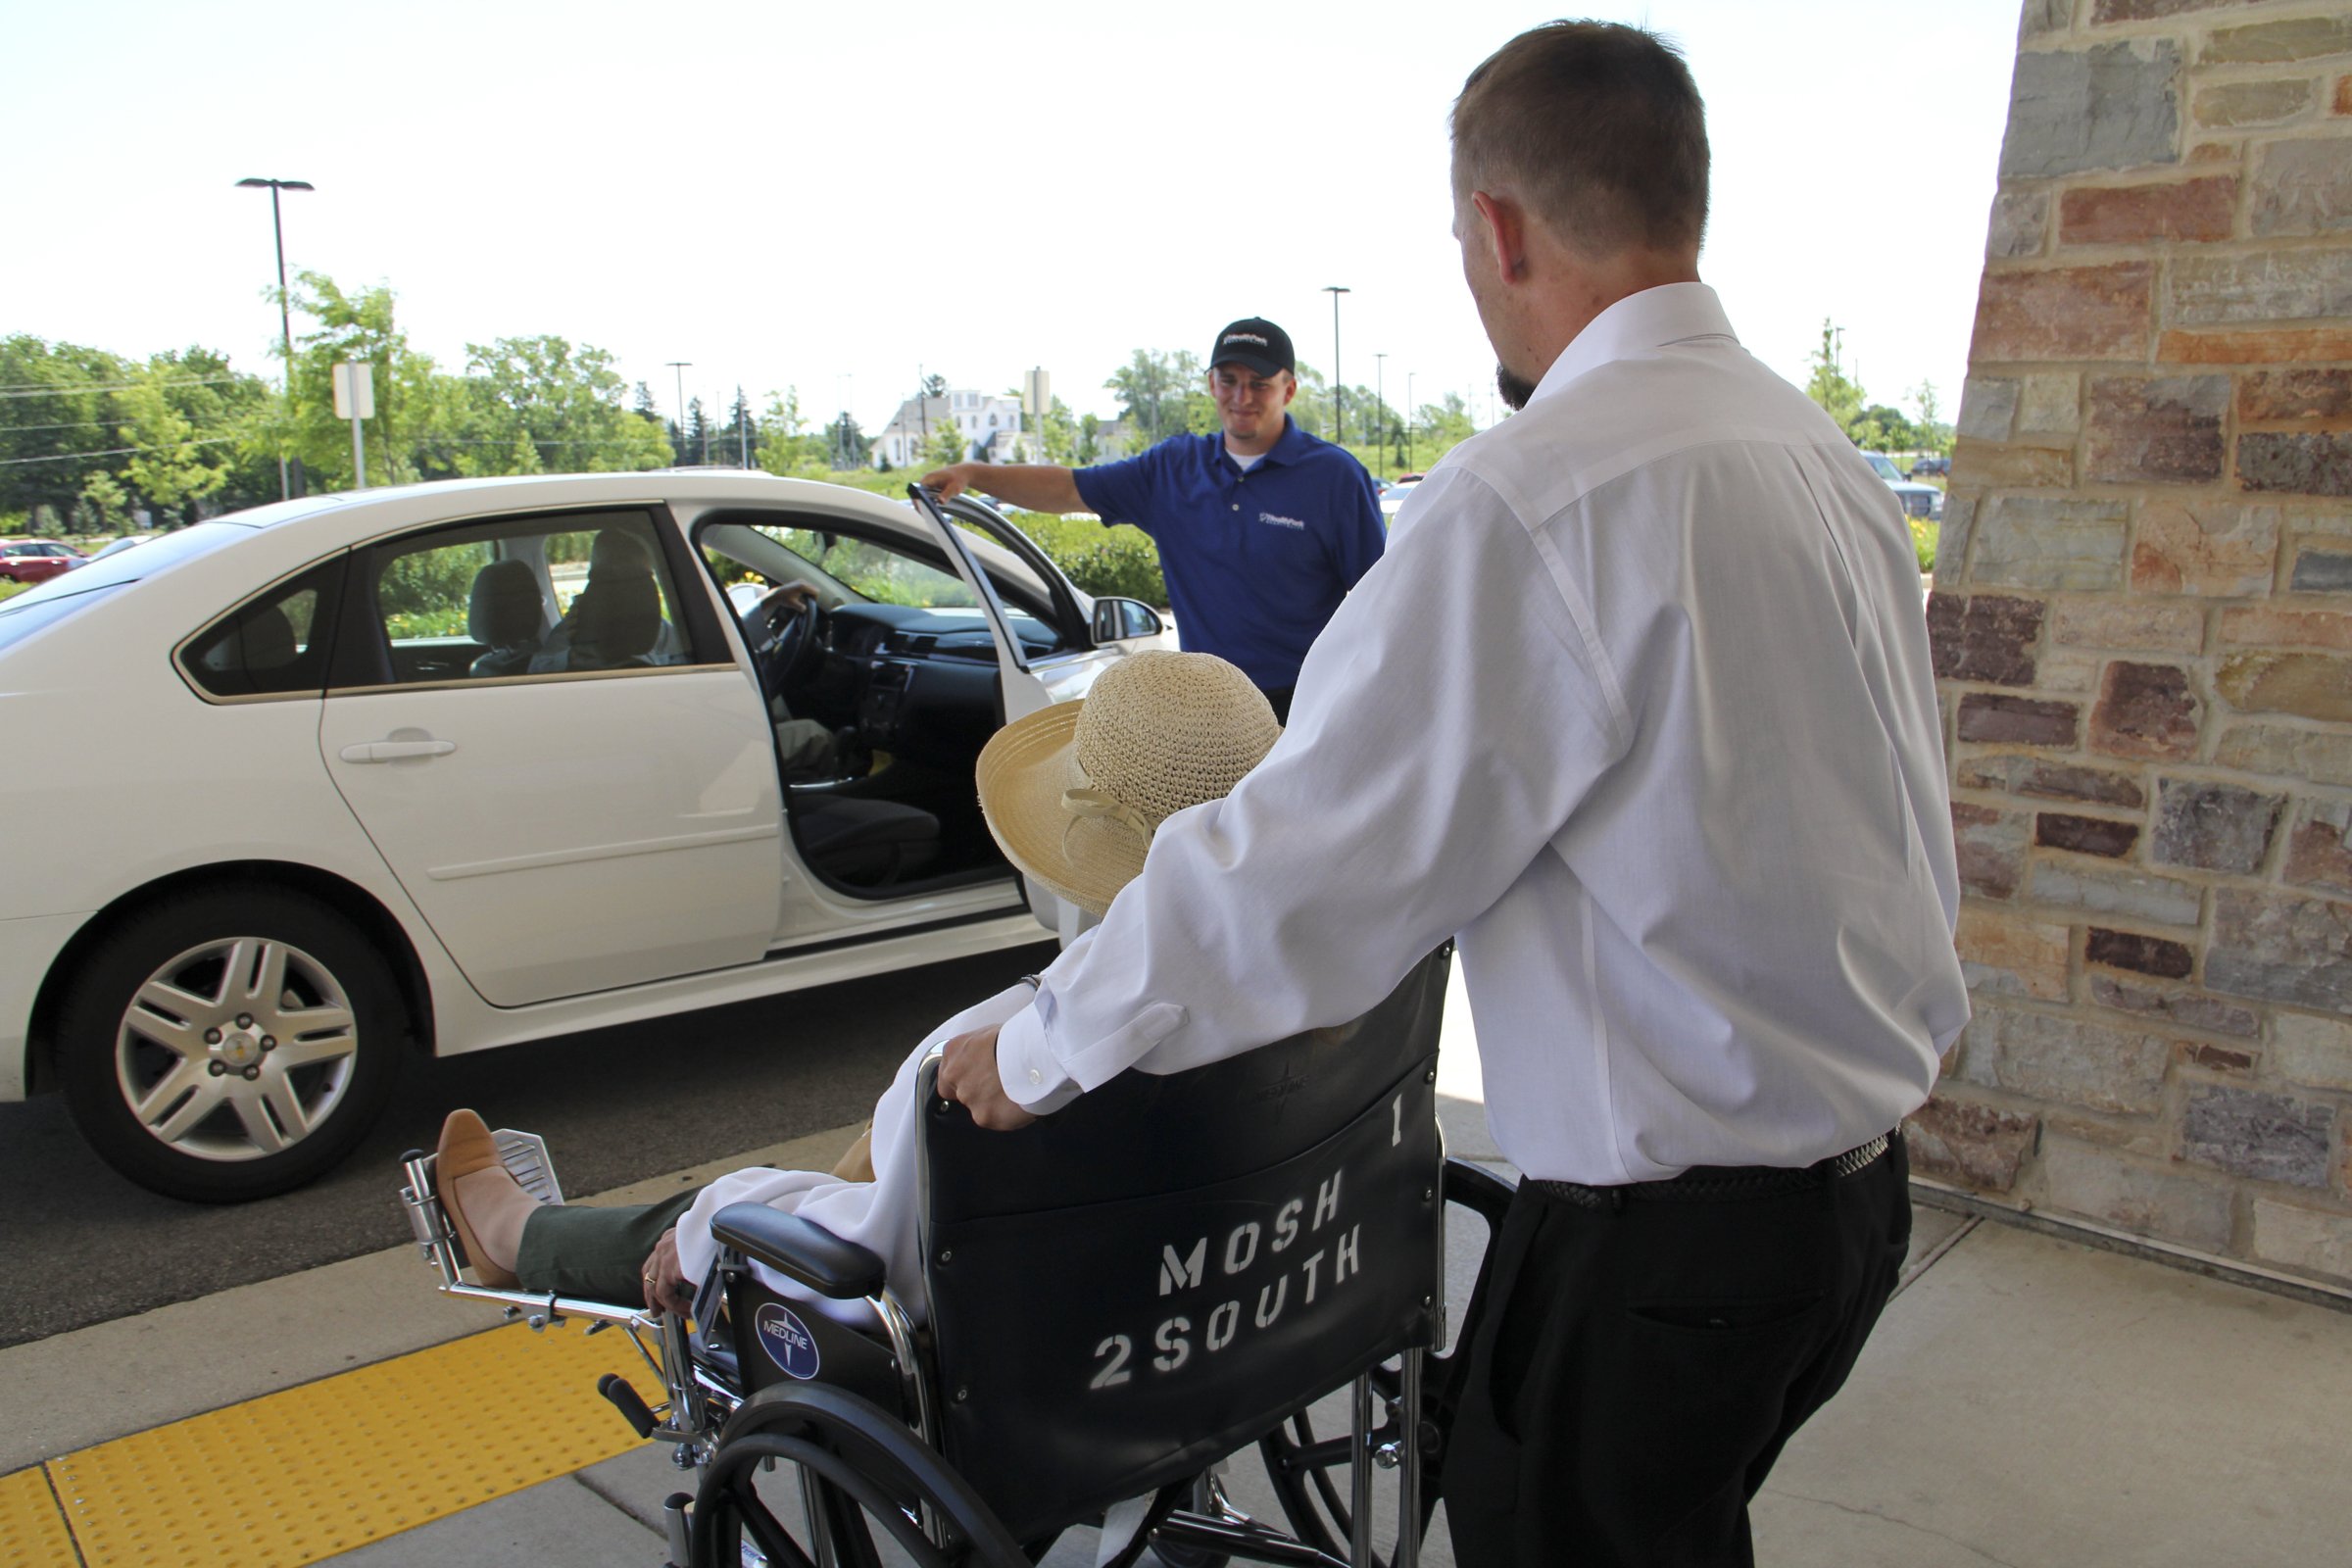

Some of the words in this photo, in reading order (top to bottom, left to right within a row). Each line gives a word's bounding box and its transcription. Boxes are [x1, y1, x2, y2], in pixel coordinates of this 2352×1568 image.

[1391, 1093, 1402, 1148] 1
[1159, 1169, 1343, 1296] MOSH
[763, 1319, 808, 1351] MEDLINE
